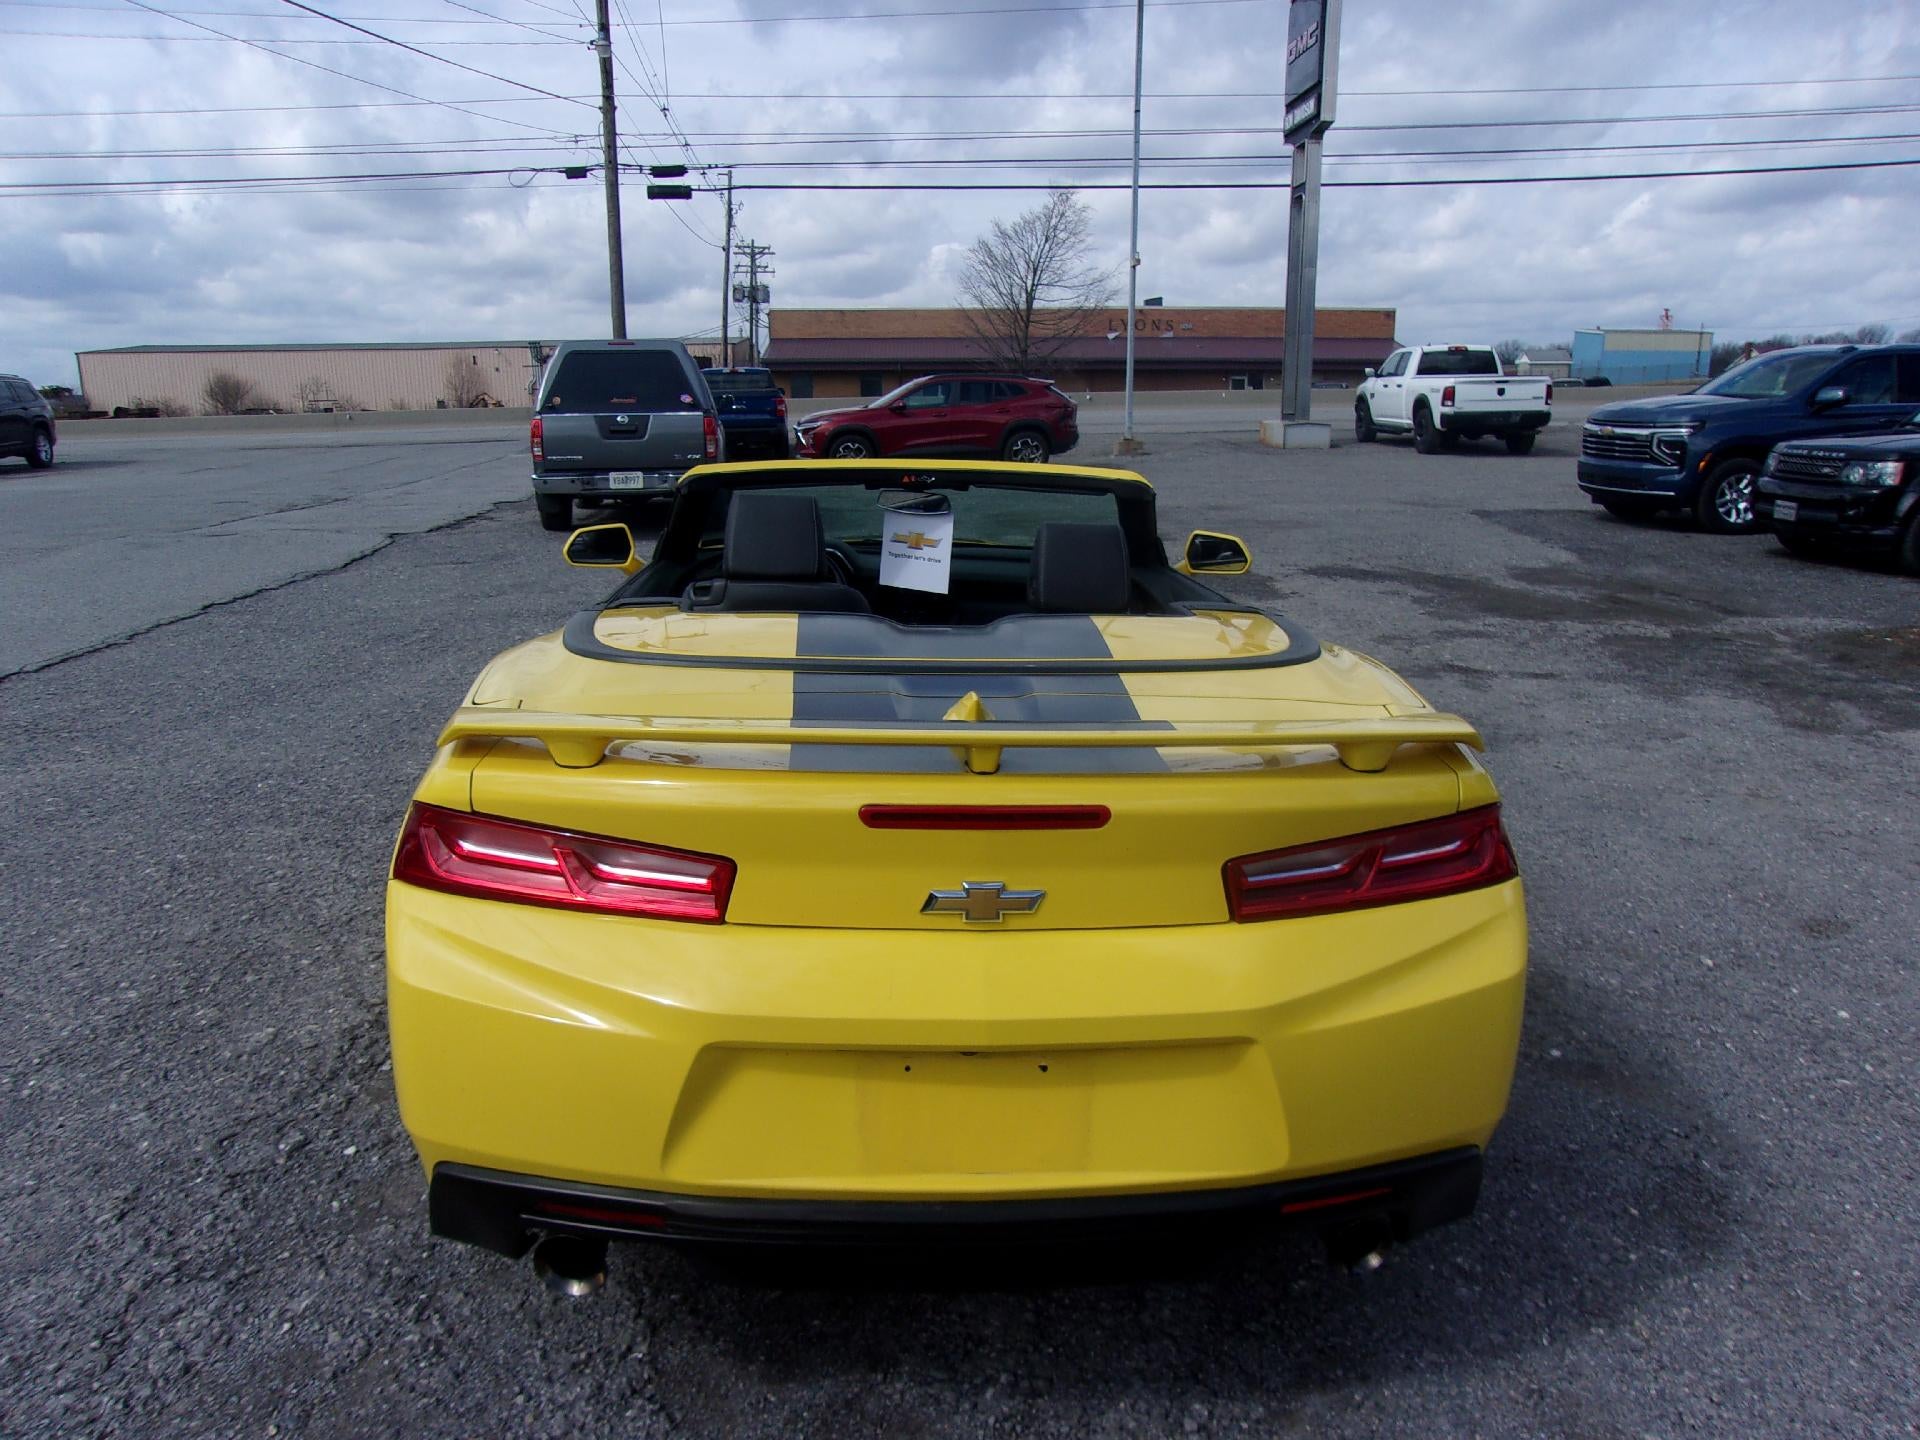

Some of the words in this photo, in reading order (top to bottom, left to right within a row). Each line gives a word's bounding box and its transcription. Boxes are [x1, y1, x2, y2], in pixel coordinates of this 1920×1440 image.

[1287, 20, 1319, 65] GMC
[1108, 318, 1174, 331] LYONS
[888, 550, 913, 560] Together
